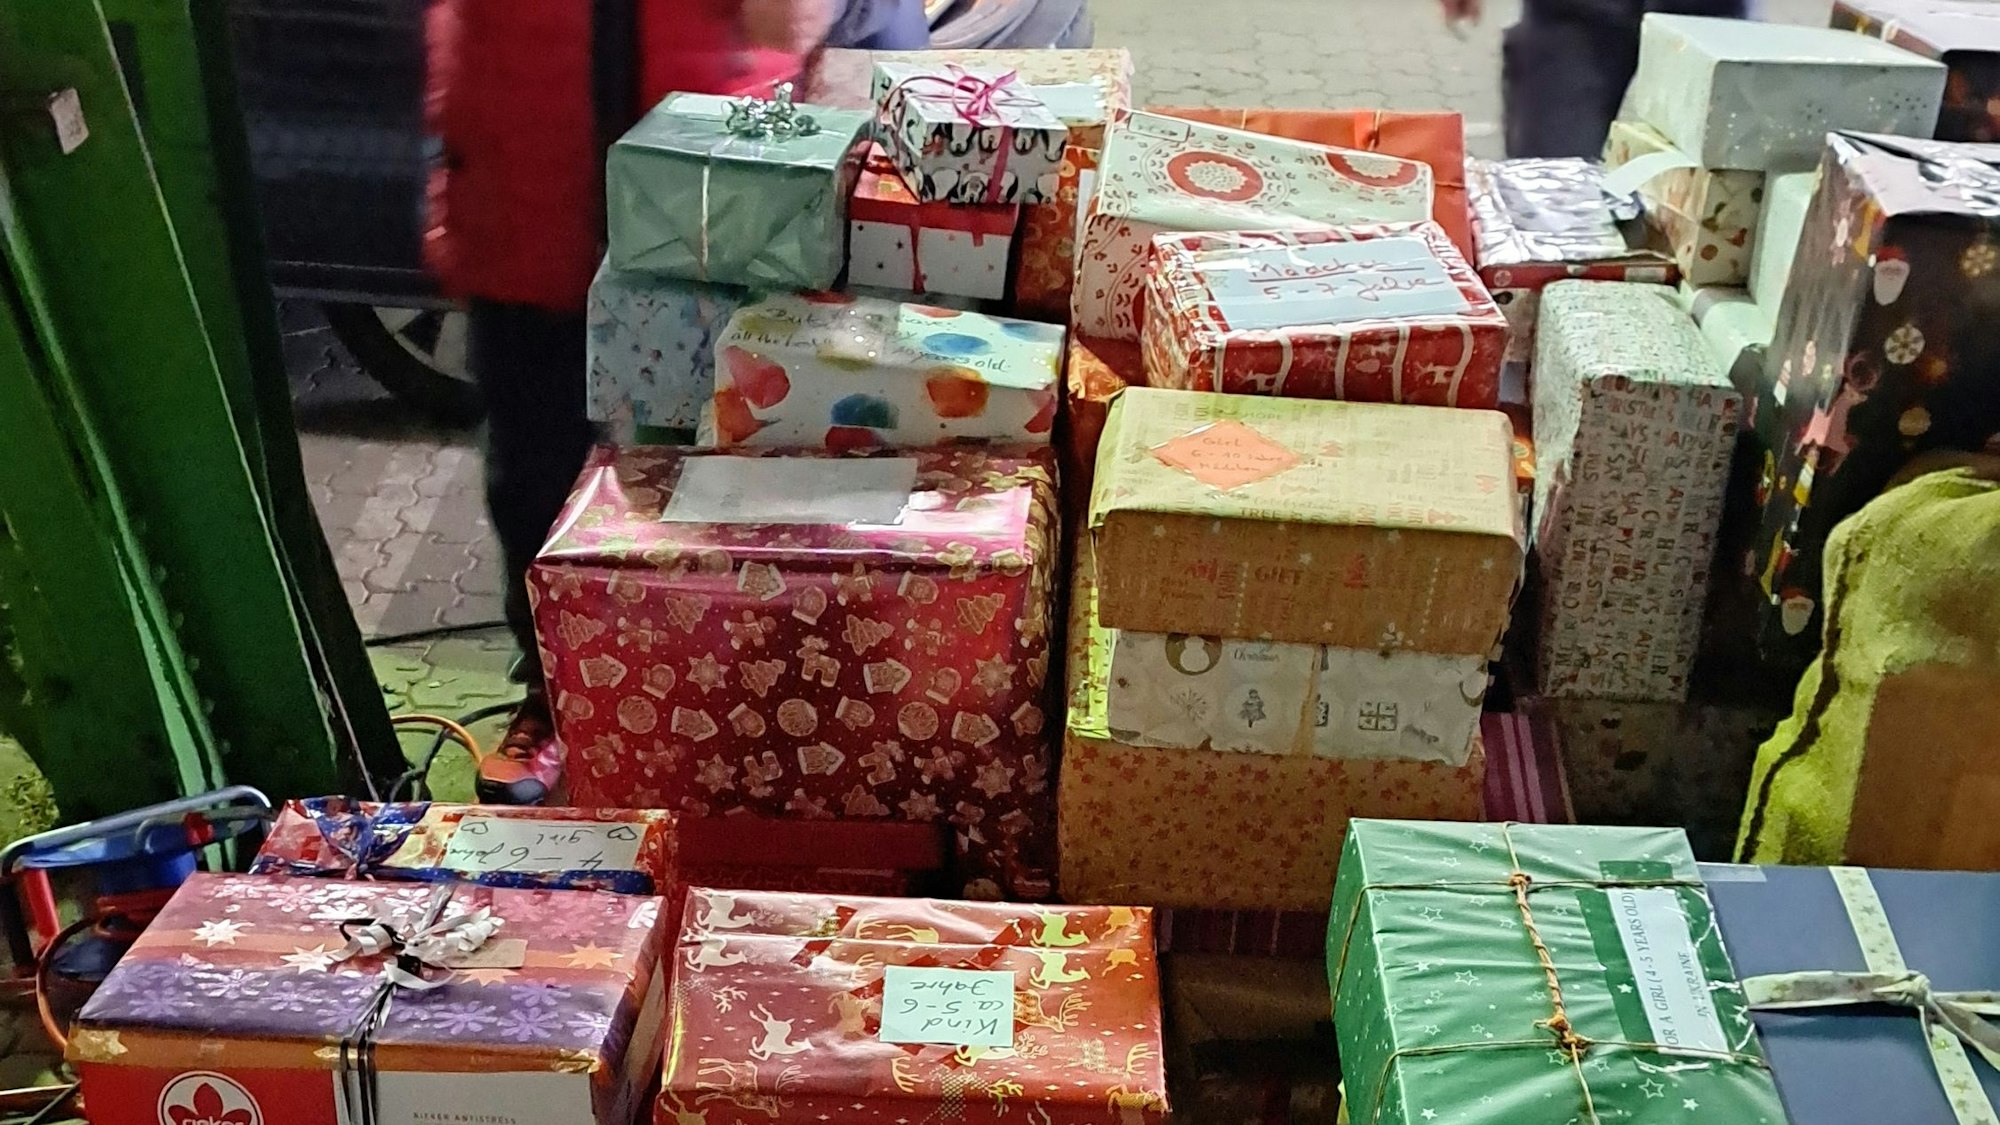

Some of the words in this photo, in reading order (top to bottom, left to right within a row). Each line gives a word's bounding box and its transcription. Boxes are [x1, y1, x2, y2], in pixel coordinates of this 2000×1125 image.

[1629, 918, 1649, 952] YEARS
[909, 979, 994, 996] Jahre
[1651, 983, 1669, 1012] GIRL
[920, 1017, 998, 1036] Kind
